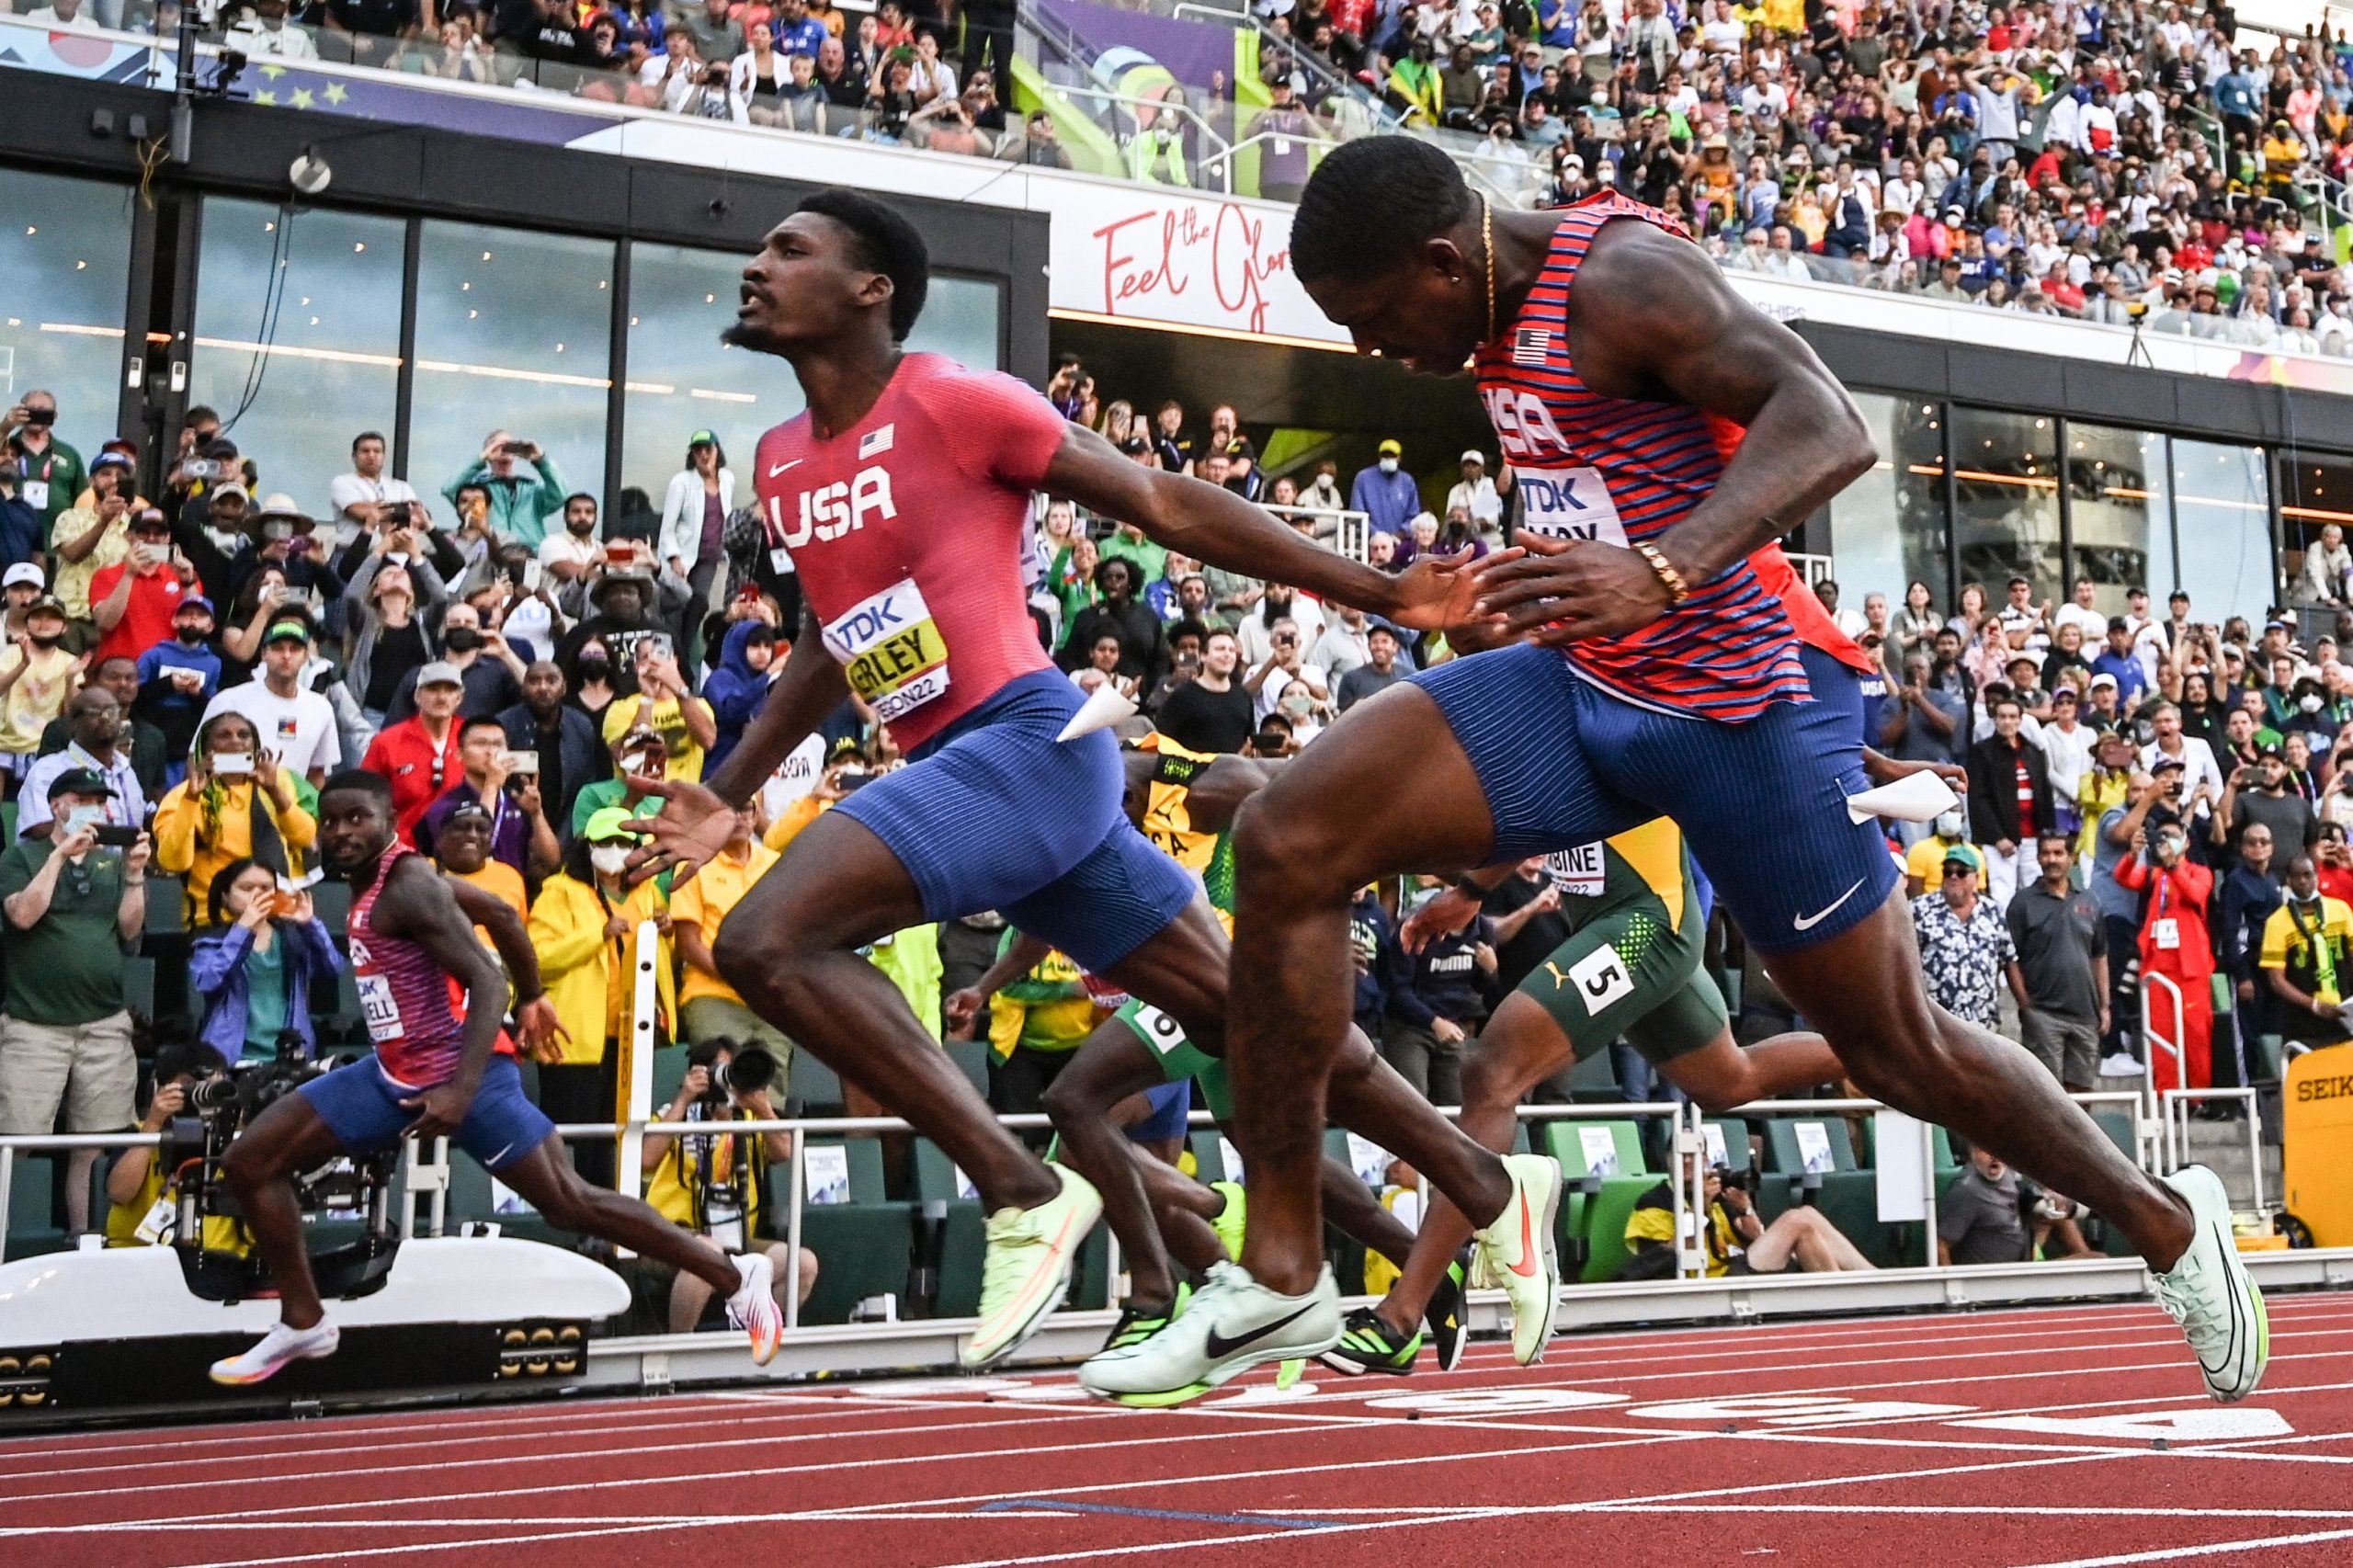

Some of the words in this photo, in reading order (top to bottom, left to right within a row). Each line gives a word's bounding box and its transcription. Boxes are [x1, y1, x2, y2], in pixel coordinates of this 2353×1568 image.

[1093, 209, 1188, 315] Feel
[1177, 206, 1211, 246] the
[1213, 201, 1291, 333] Glor
[1753, 300, 1807, 320] SHIPS
[770, 465, 898, 549] USA
[1517, 476, 1586, 513] TDK
[837, 597, 903, 649] TDK
[848, 628, 927, 697] ERLEY
[1549, 846, 1597, 872] BINE
[1585, 964, 1621, 997] 5
[367, 1000, 394, 1021] ELL
[2297, 1074, 2353, 1102] SEIK
